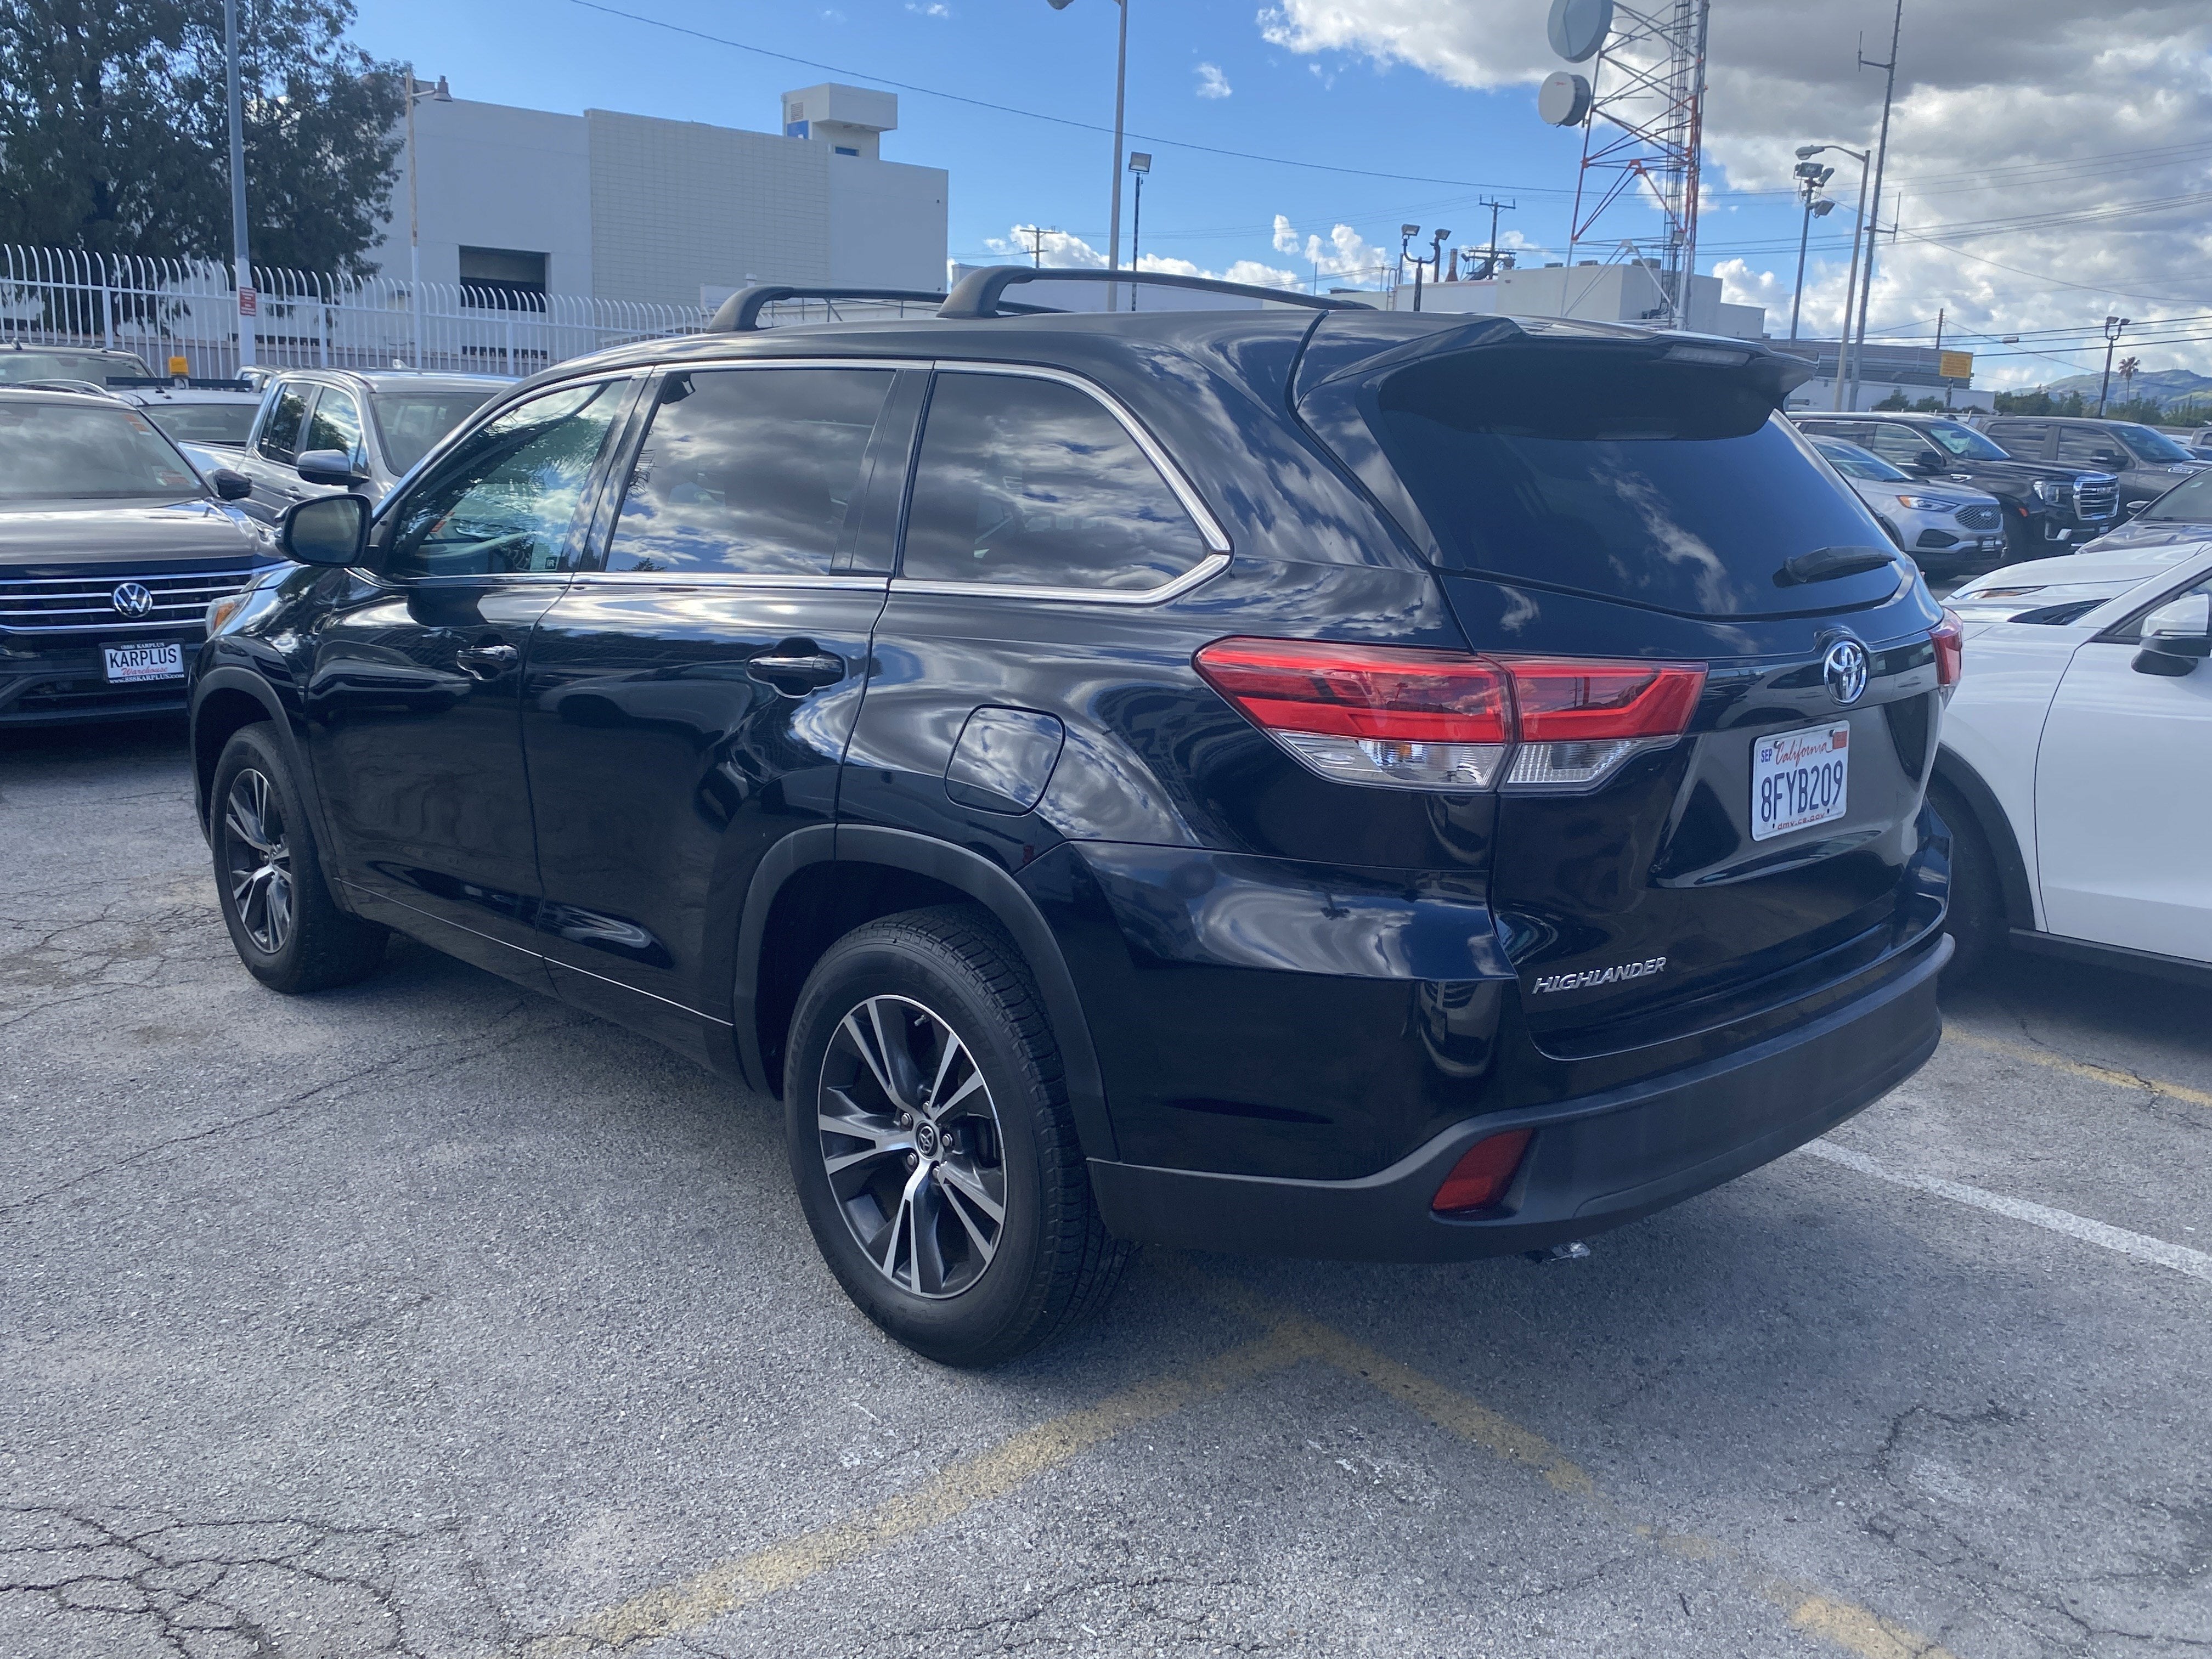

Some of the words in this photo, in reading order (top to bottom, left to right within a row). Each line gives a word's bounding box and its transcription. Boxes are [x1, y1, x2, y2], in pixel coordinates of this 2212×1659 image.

[110, 648, 177, 668] KARPLUS
[121, 665, 168, 675] Warehouse
[1761, 748, 1773, 763] SEP
[1775, 738, 1833, 767] California
[1761, 760, 1843, 822] 8FYB209
[1778, 812, 1825, 830] dmv.ca.gov
[1531, 957, 1667, 995] HIGHLANDER
